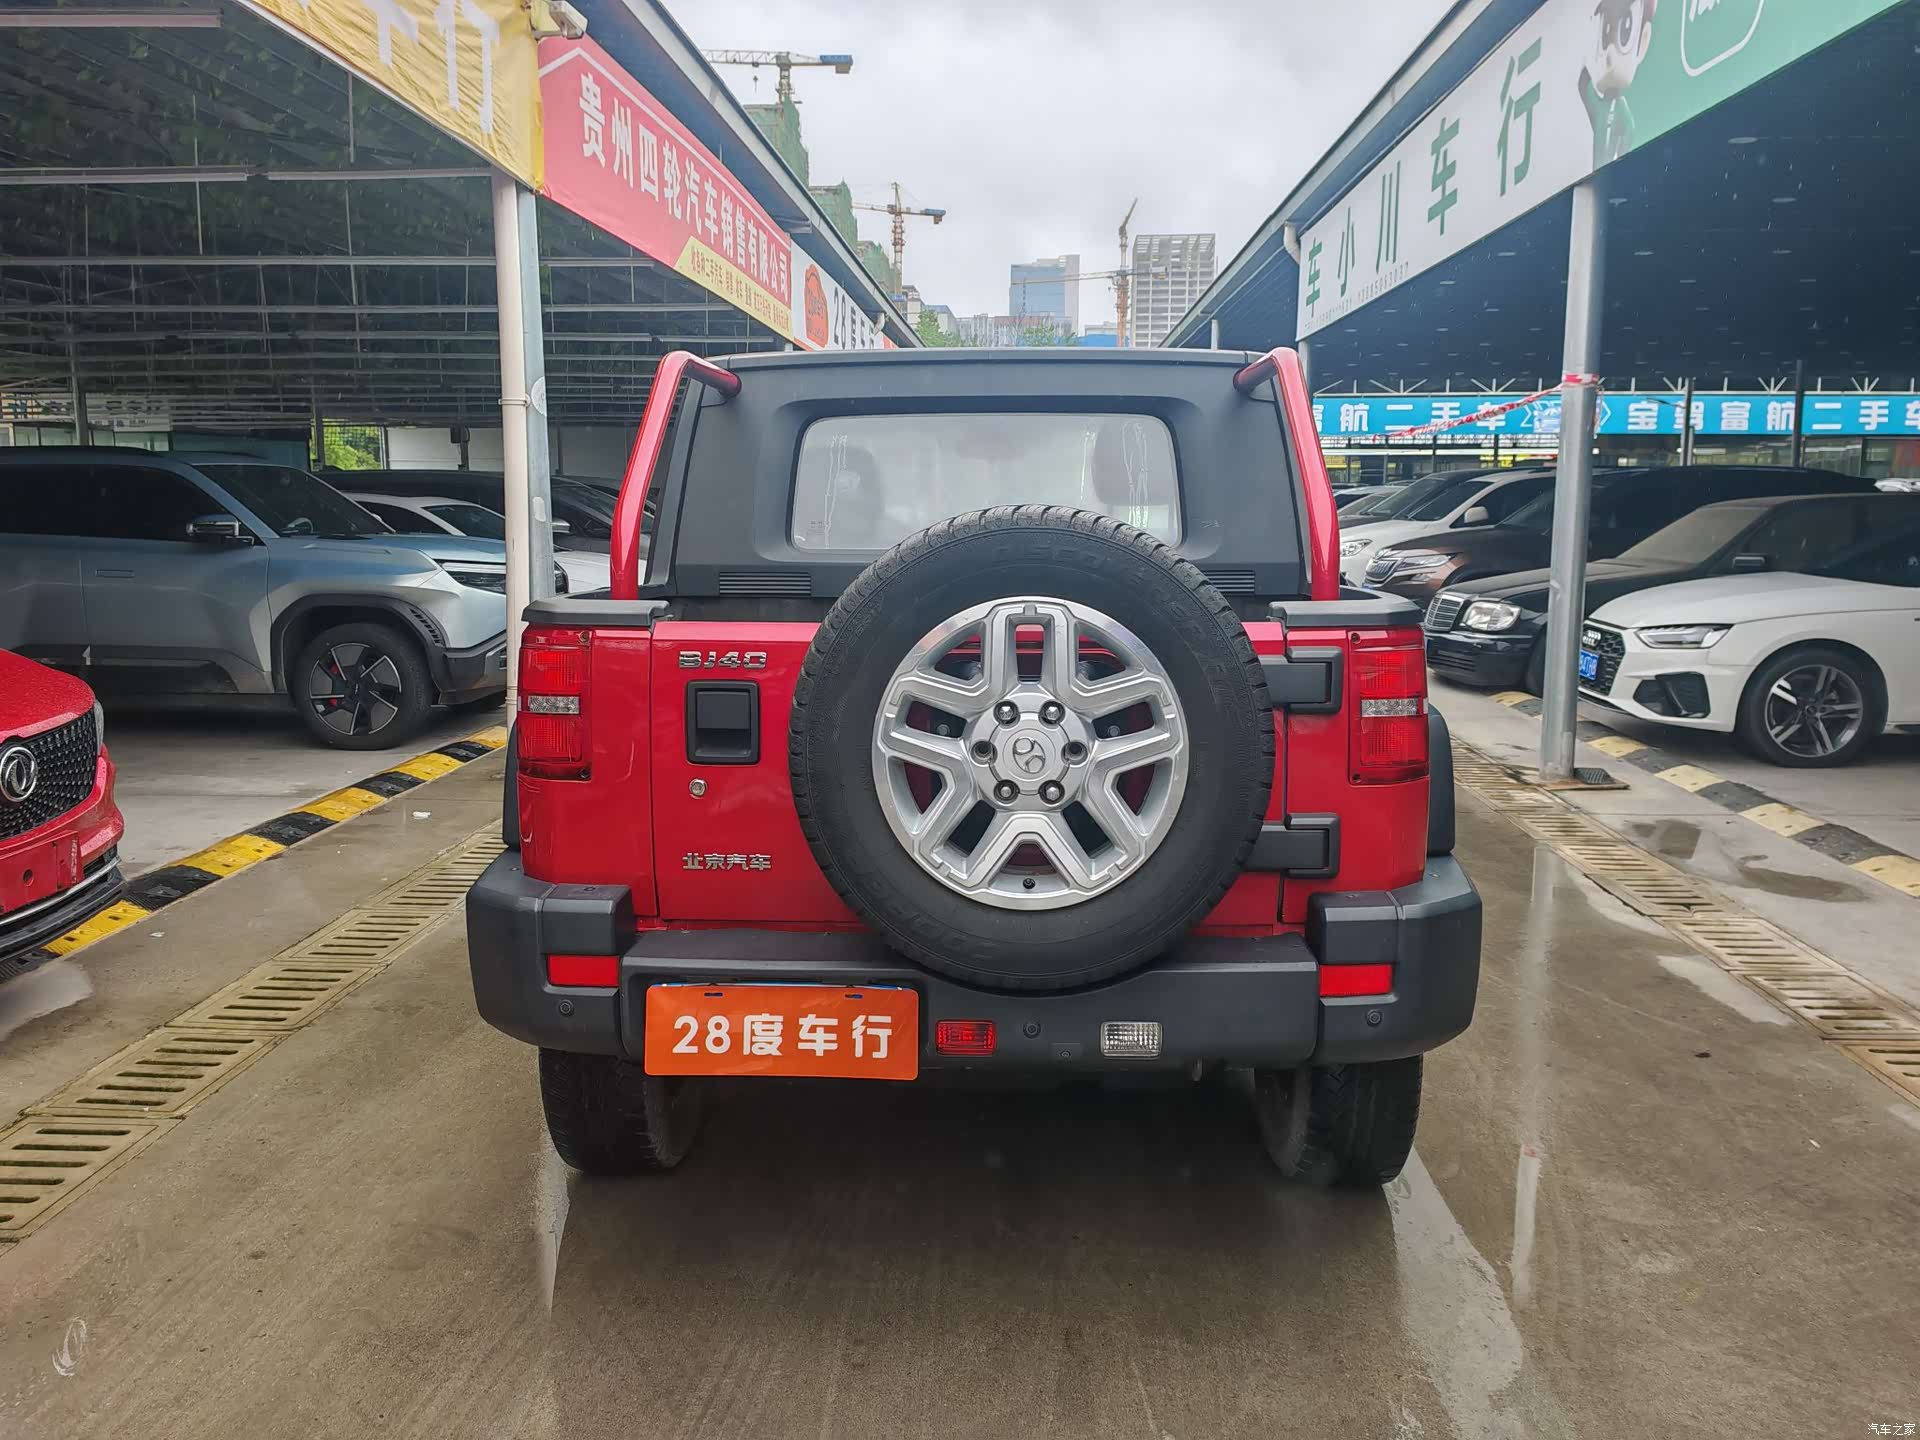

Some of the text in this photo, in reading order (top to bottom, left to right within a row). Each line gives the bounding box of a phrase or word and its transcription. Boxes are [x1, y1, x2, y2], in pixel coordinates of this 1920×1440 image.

[578, 72, 789, 302] 贵州四轮汽车销售有限公司
[1305, 36, 1543, 318] 车小川车行
[678, 651, 767, 668] BJ40
[682, 853, 771, 871] 北京汽车
[672, 1013, 893, 1058] 28度车行
